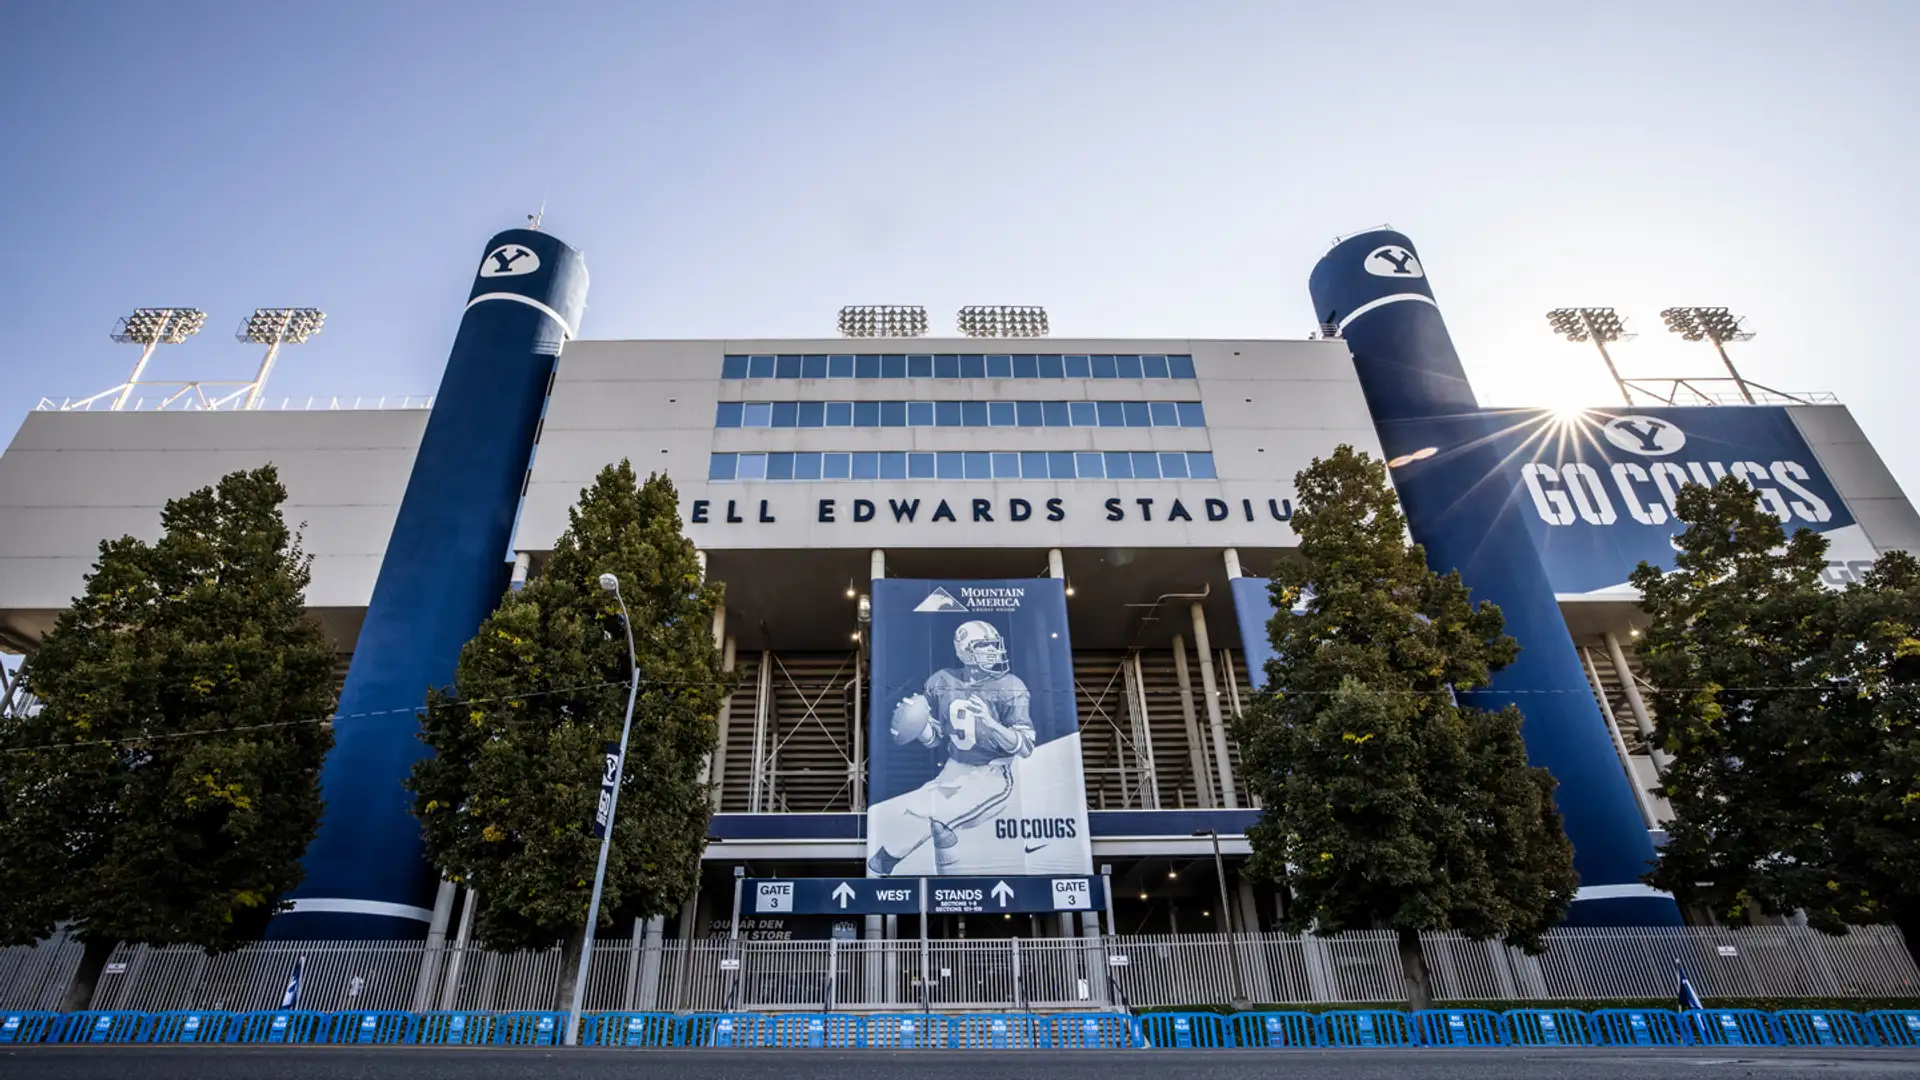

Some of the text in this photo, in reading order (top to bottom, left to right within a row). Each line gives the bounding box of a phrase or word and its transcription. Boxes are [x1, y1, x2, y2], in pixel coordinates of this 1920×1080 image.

[490, 248, 530, 273] Y
[1374, 249, 1413, 274] Y
[1615, 420, 1668, 451] Y
[1520, 462, 1618, 526] GO
[691, 499, 776, 523] ELL
[818, 498, 1065, 523] EDWARDS
[950, 699, 978, 750] 9
[995, 818, 1076, 839] GO COUGS
[760, 885, 791, 895] GATE
[1055, 882, 1087, 892] GATE
[876, 890, 911, 901] WEST
[935, 889, 983, 900] STANDS
[1068, 895, 1076, 905] 3
[770, 898, 779, 908] 3
[710, 920, 784, 929] OUAR DEN
[751, 931, 792, 940] STORE
